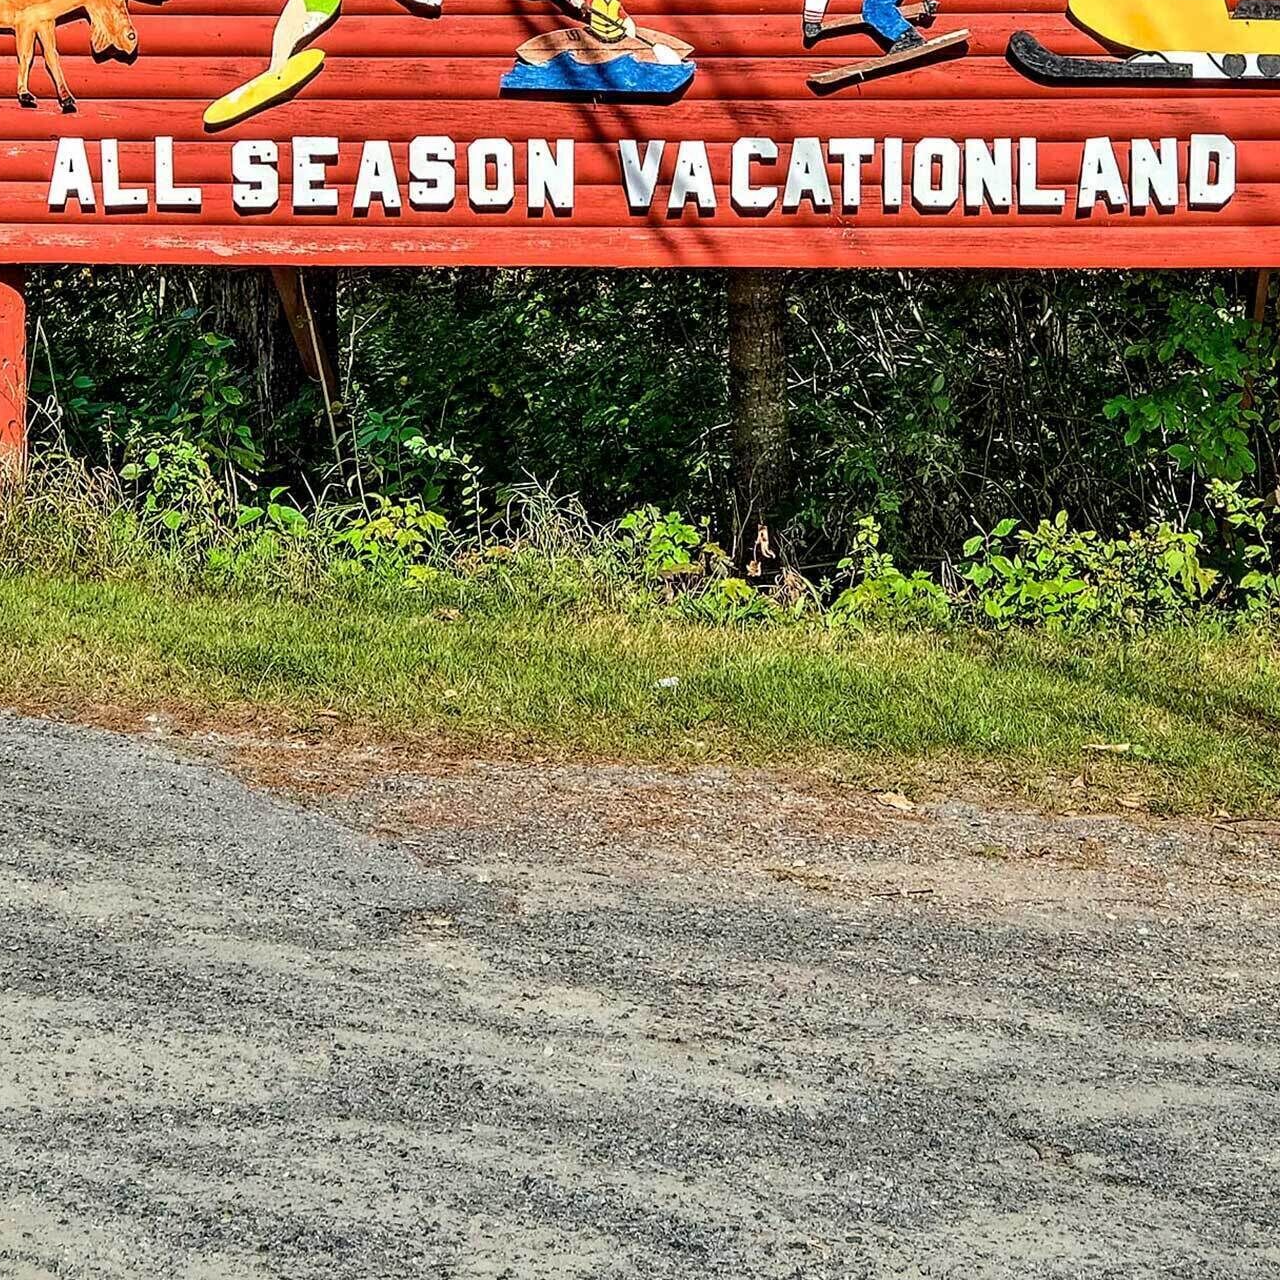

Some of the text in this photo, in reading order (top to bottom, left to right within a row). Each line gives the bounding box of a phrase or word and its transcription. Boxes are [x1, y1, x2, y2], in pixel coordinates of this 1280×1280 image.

[48, 134, 1236, 209] ALL SEASON VACATIONLAND
